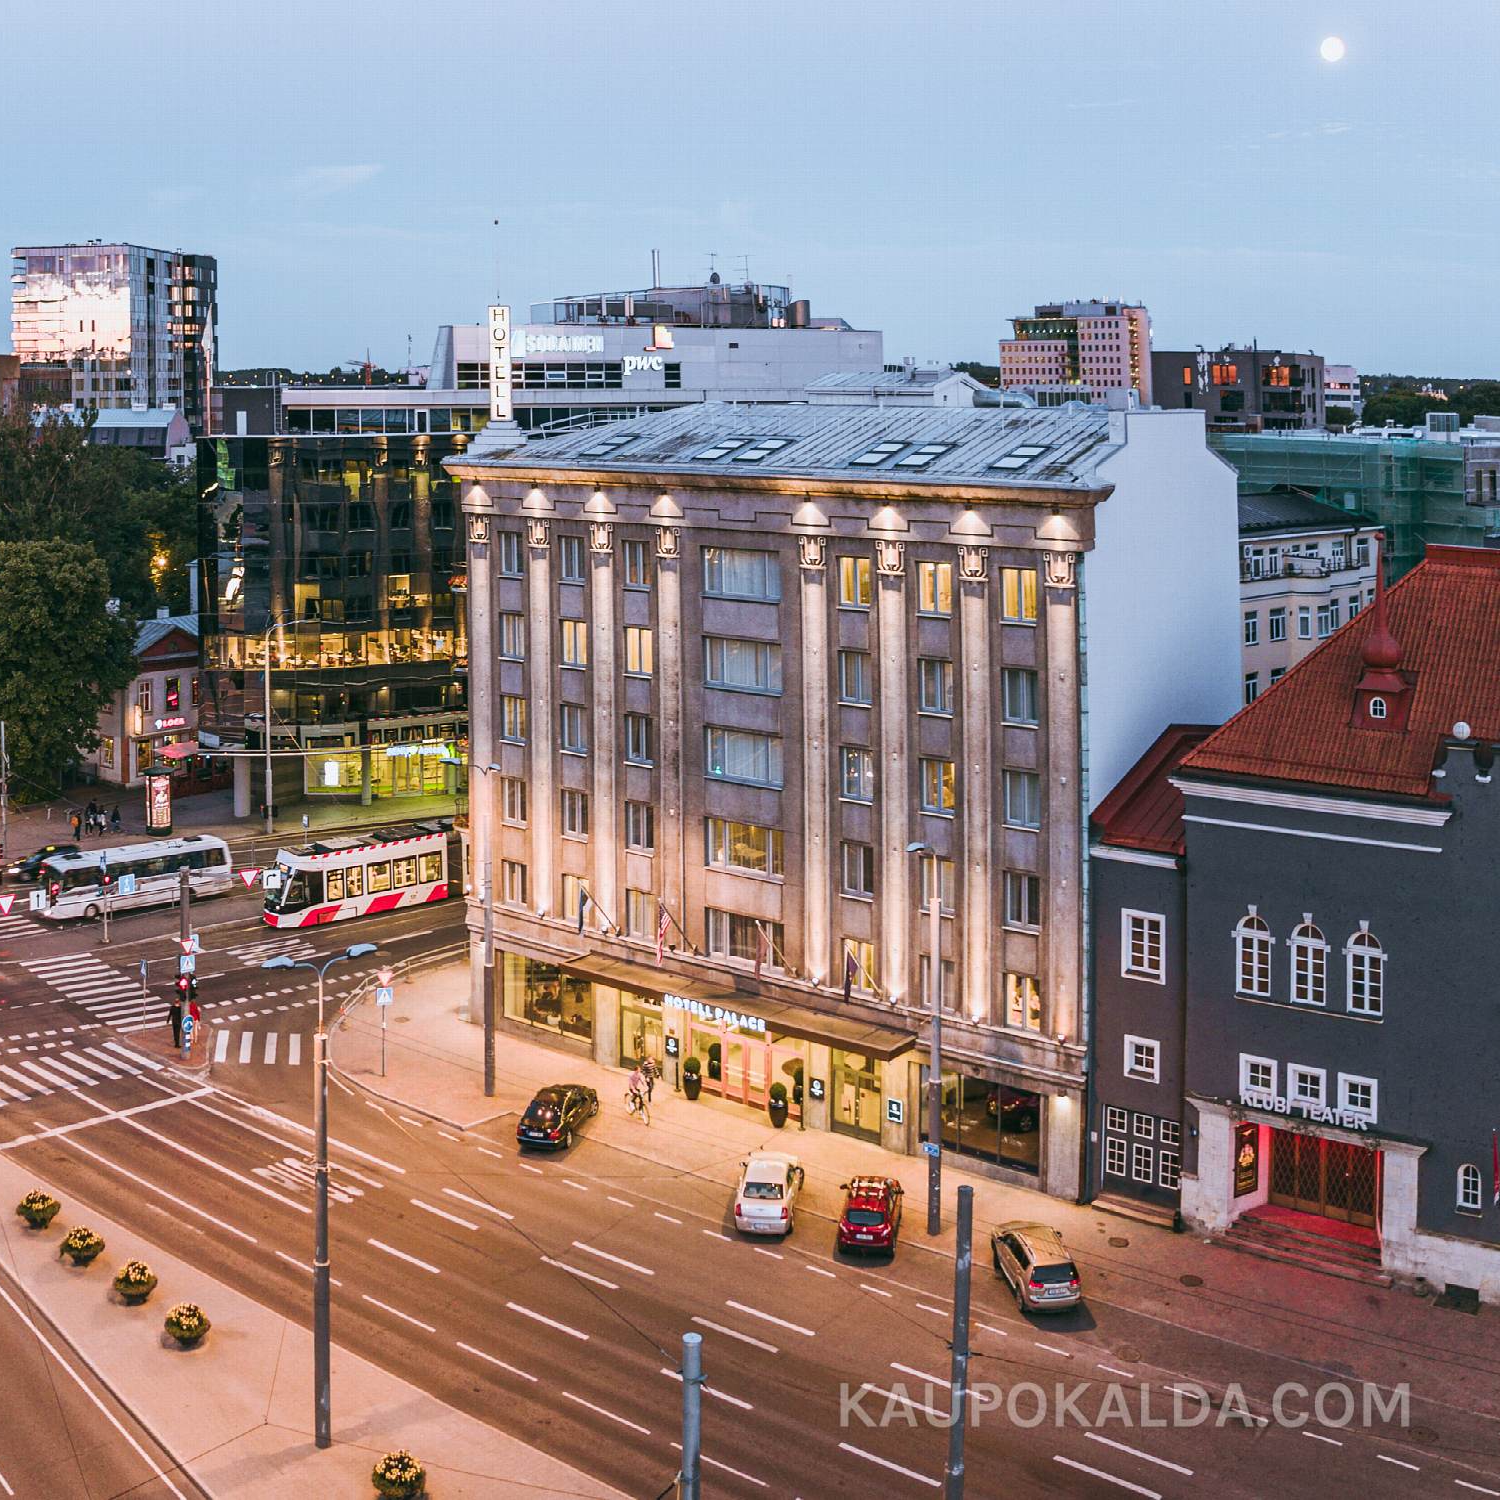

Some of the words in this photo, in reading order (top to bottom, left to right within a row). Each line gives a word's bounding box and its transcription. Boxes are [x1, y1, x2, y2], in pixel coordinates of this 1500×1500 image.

[492, 309, 507, 418] HOTELL
[623, 356, 663, 375] pwc
[664, 993, 714, 1019] HOTELL
[714, 1007, 766, 1033] PALACE
[1240, 1090, 1291, 1115] KLUBI
[1300, 1103, 1368, 1131] TEATER
